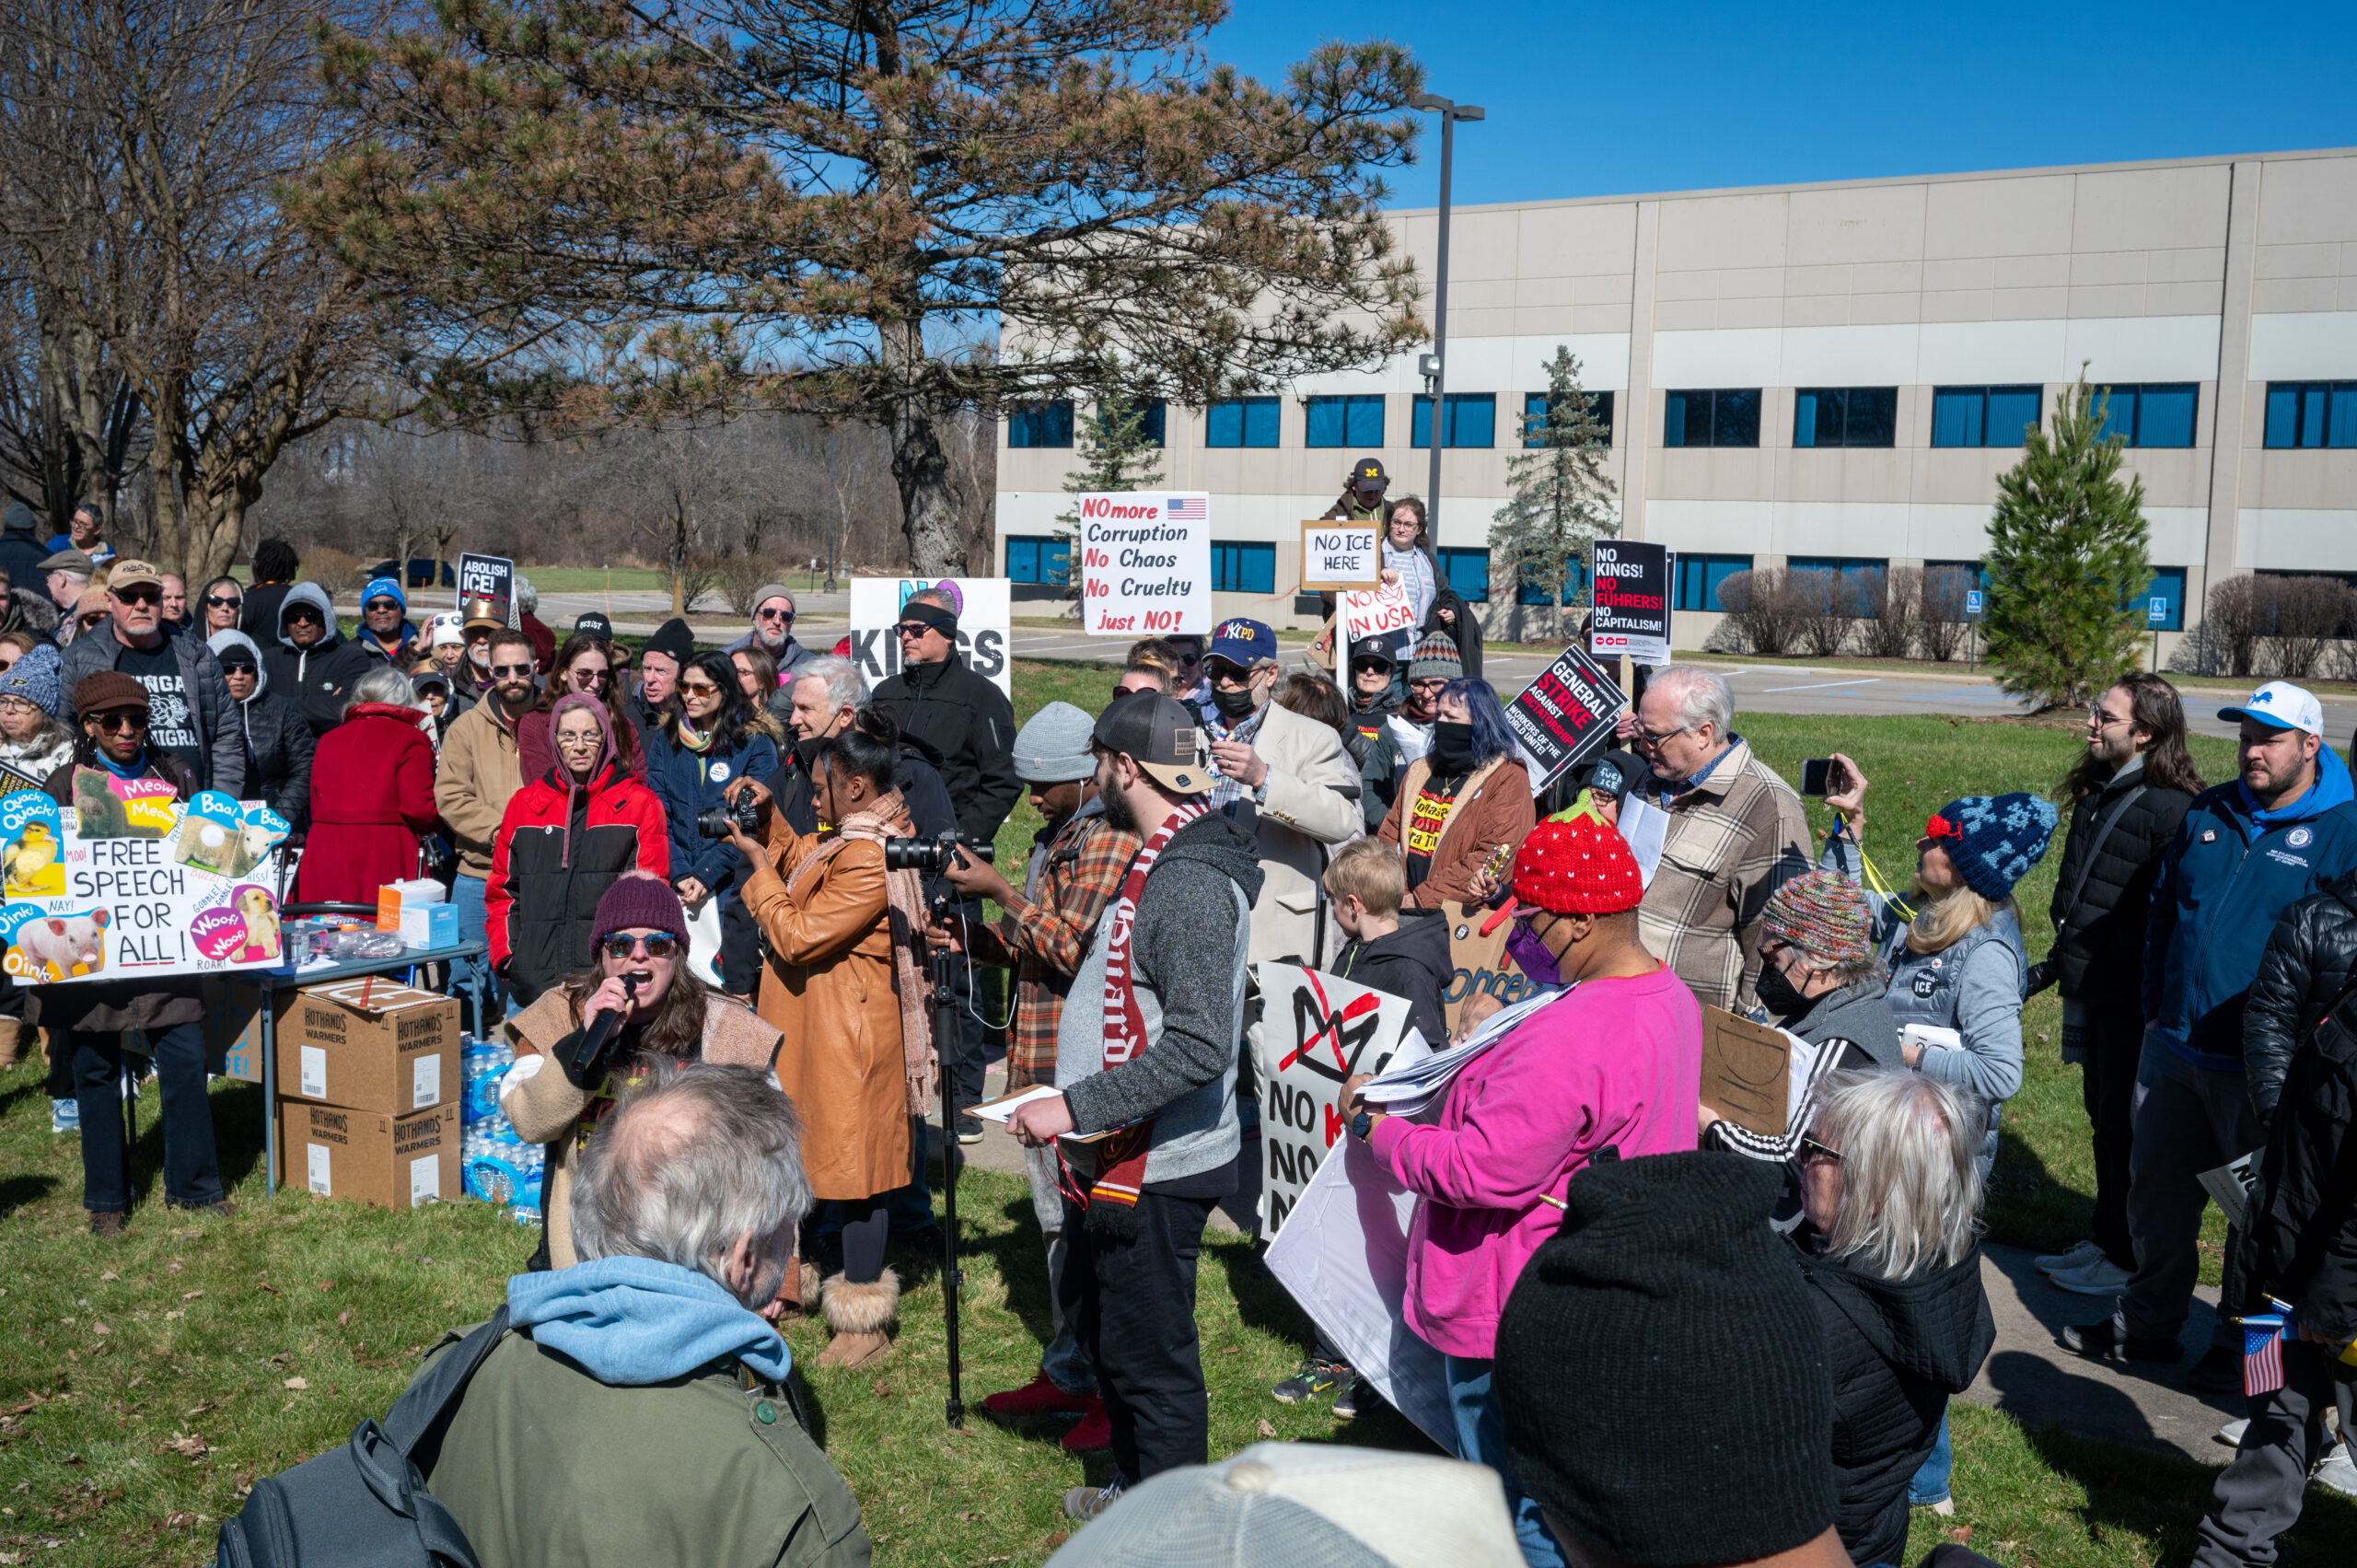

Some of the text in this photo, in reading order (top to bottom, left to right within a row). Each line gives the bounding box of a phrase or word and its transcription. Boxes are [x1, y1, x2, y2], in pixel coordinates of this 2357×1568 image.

[1365, 468, 1377, 477] M
[1087, 523, 1188, 544] Corruption
[1315, 534, 1373, 552] NO ICE
[1084, 548, 1177, 568] No Chaos
[1324, 556, 1360, 571] HERE
[1596, 548, 1617, 563] NO
[464, 561, 507, 577] ABOLISH
[1596, 563, 1643, 578] KINGS!
[463, 572, 494, 594] ICE!
[1085, 576, 1192, 598] No Cruelty
[1596, 577, 1617, 591] NO
[1596, 590, 1663, 610] FÜHRERS!
[1097, 609, 1183, 633] just NO!
[1349, 606, 1414, 634] IN USA
[1596, 607, 1611, 617] NO
[1595, 617, 1662, 632] CAPITALISM!
[851, 629, 1004, 678] KIGS
[1538, 673, 1594, 729] STRIKE
[1552, 661, 1607, 720] GENERAL
[1528, 685, 1564, 719] AGAINST
[1521, 691, 1576, 748] DICTATORSHIP!
[1505, 711, 1526, 735] WORLD
[1523, 732, 1547, 755] UNITE!
[1509, 703, 1562, 759] WORKERS OF THE
[123, 780, 178, 799] Meow!
[1599, 778, 1618, 790] ICE
[4, 793, 44, 812] Quack!
[133, 801, 177, 826] Meow!
[201, 793, 238, 817] Baa!
[3, 804, 56, 830] Quack!
[261, 808, 290, 830] Baa!
[65, 847, 87, 863] MOO!
[93, 840, 161, 865] FREE
[74, 868, 184, 898] SPEECH
[49, 900, 74, 912] NAY!
[192, 884, 221, 914] GOBBLE!
[0, 905, 35, 934] Oink!
[114, 902, 171, 931] FOR
[191, 913, 238, 936] Woof!
[210, 930, 246, 957] Woof!
[4, 953, 55, 982] Oink!
[197, 959, 226, 970] ROAR!
[1914, 981, 1933, 993] ICE
[1917, 971, 1936, 983] abolish
[305, 1007, 347, 1033] HOTHANDS
[398, 1013, 443, 1041] HOTHANDS
[305, 1028, 347, 1045] WARMERS
[398, 1034, 443, 1052] WARMERS
[1269, 1080, 1316, 1133] NO
[310, 1106, 348, 1133] HOTHANDS
[394, 1114, 442, 1144] HOTHANDS
[311, 1127, 348, 1145] WARMERS
[394, 1135, 442, 1156] WARMERS
[1269, 1137, 1319, 1185] NO
